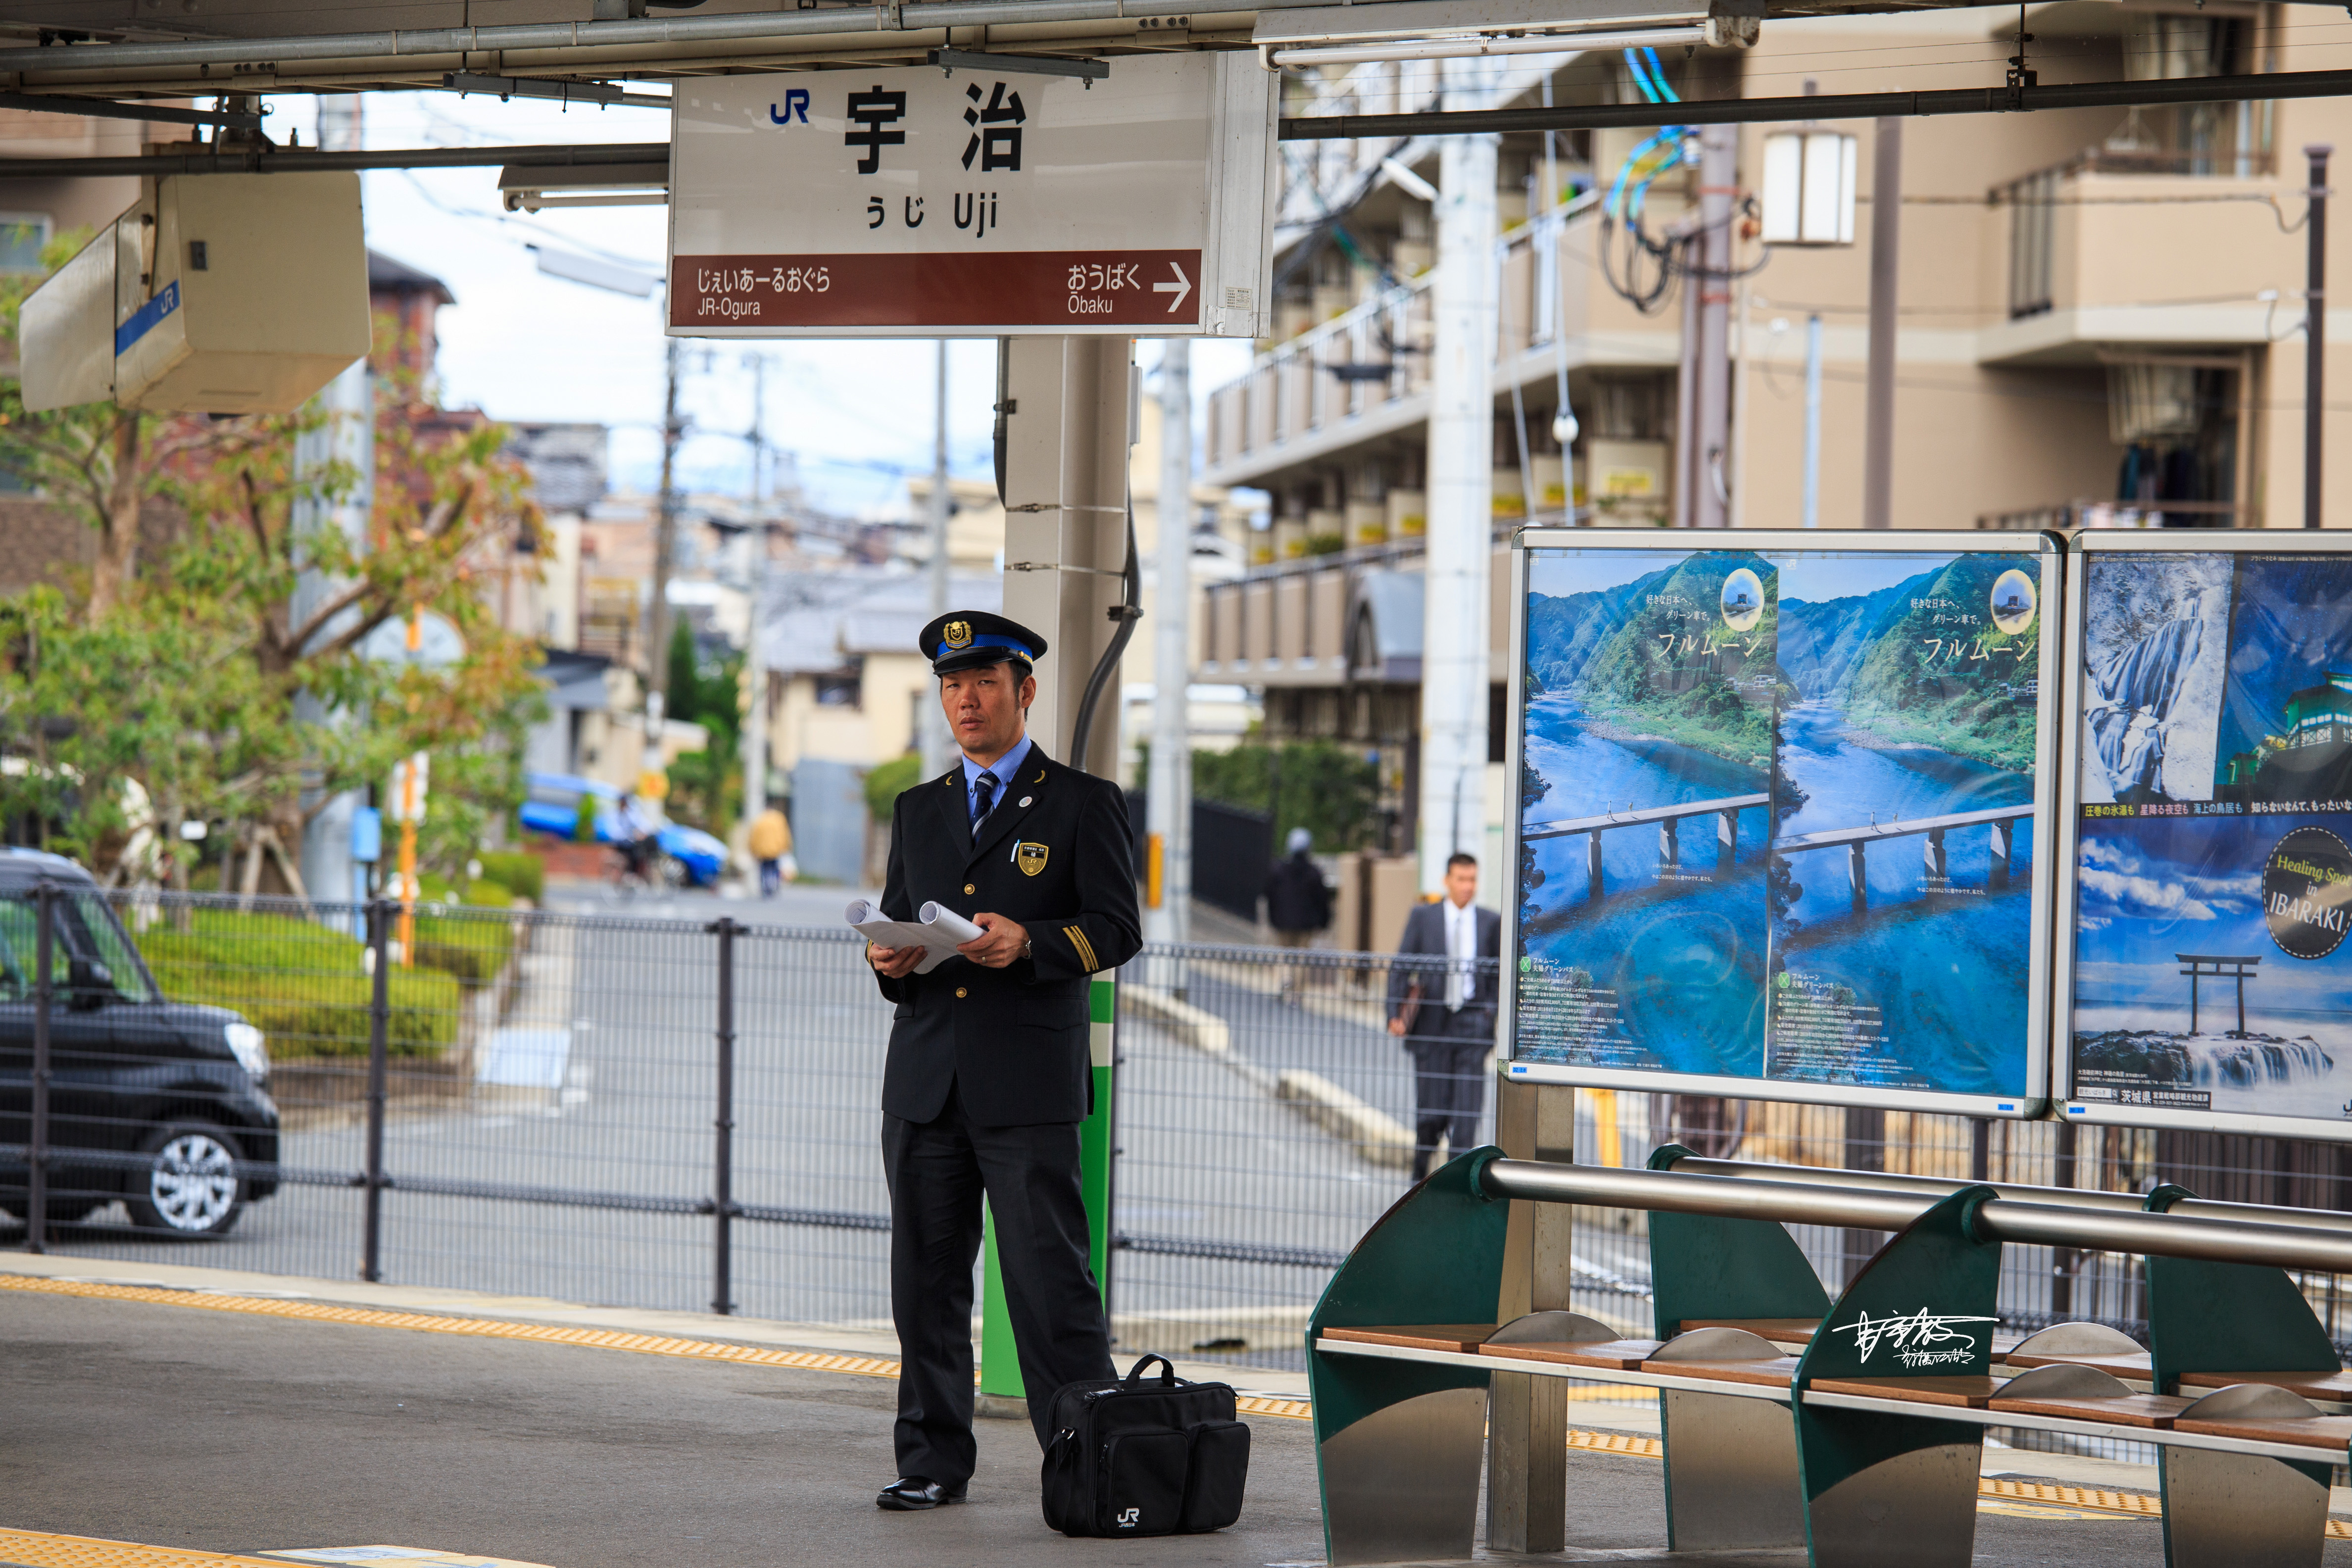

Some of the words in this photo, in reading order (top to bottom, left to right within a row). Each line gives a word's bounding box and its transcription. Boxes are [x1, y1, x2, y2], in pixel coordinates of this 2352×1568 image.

[771, 90, 809, 125] JR
[845, 82, 1027, 174] 宇治
[867, 196, 924, 229] うじ
[954, 192, 997, 239] Uji
[697, 266, 830, 294] じぇいあーるおぐら
[1068, 262, 1140, 291] おうばく
[161, 287, 174, 314] JR
[698, 299, 761, 319] JR-Ogura
[1068, 290, 1113, 314] Ōbaku
[1786, 559, 1797, 568] JR
[1646, 594, 1692, 605] 好きな日本へ、
[1911, 598, 1960, 609] 好きな日本へ、
[1666, 610, 1711, 621] グリーン車で。
[1932, 614, 1981, 625] グリーン車で。
[1659, 634, 1763, 657] フルムーン
[1924, 638, 2036, 664] フルムーン
[2085, 805, 2135, 817] 圧巻の氷瀑も
[2140, 803, 2189, 816] 星降る夜空も
[2194, 802, 2243, 814] 海上の鳥居も
[2277, 855, 2324, 882] Healing
[2306, 881, 2318, 896] in
[2269, 891, 2344, 932] IBARAKI
[2121, 1089, 2152, 1104] 茨城県
[2343, 1099, 2352, 1112] J
[1118, 1508, 1139, 1523] JR
